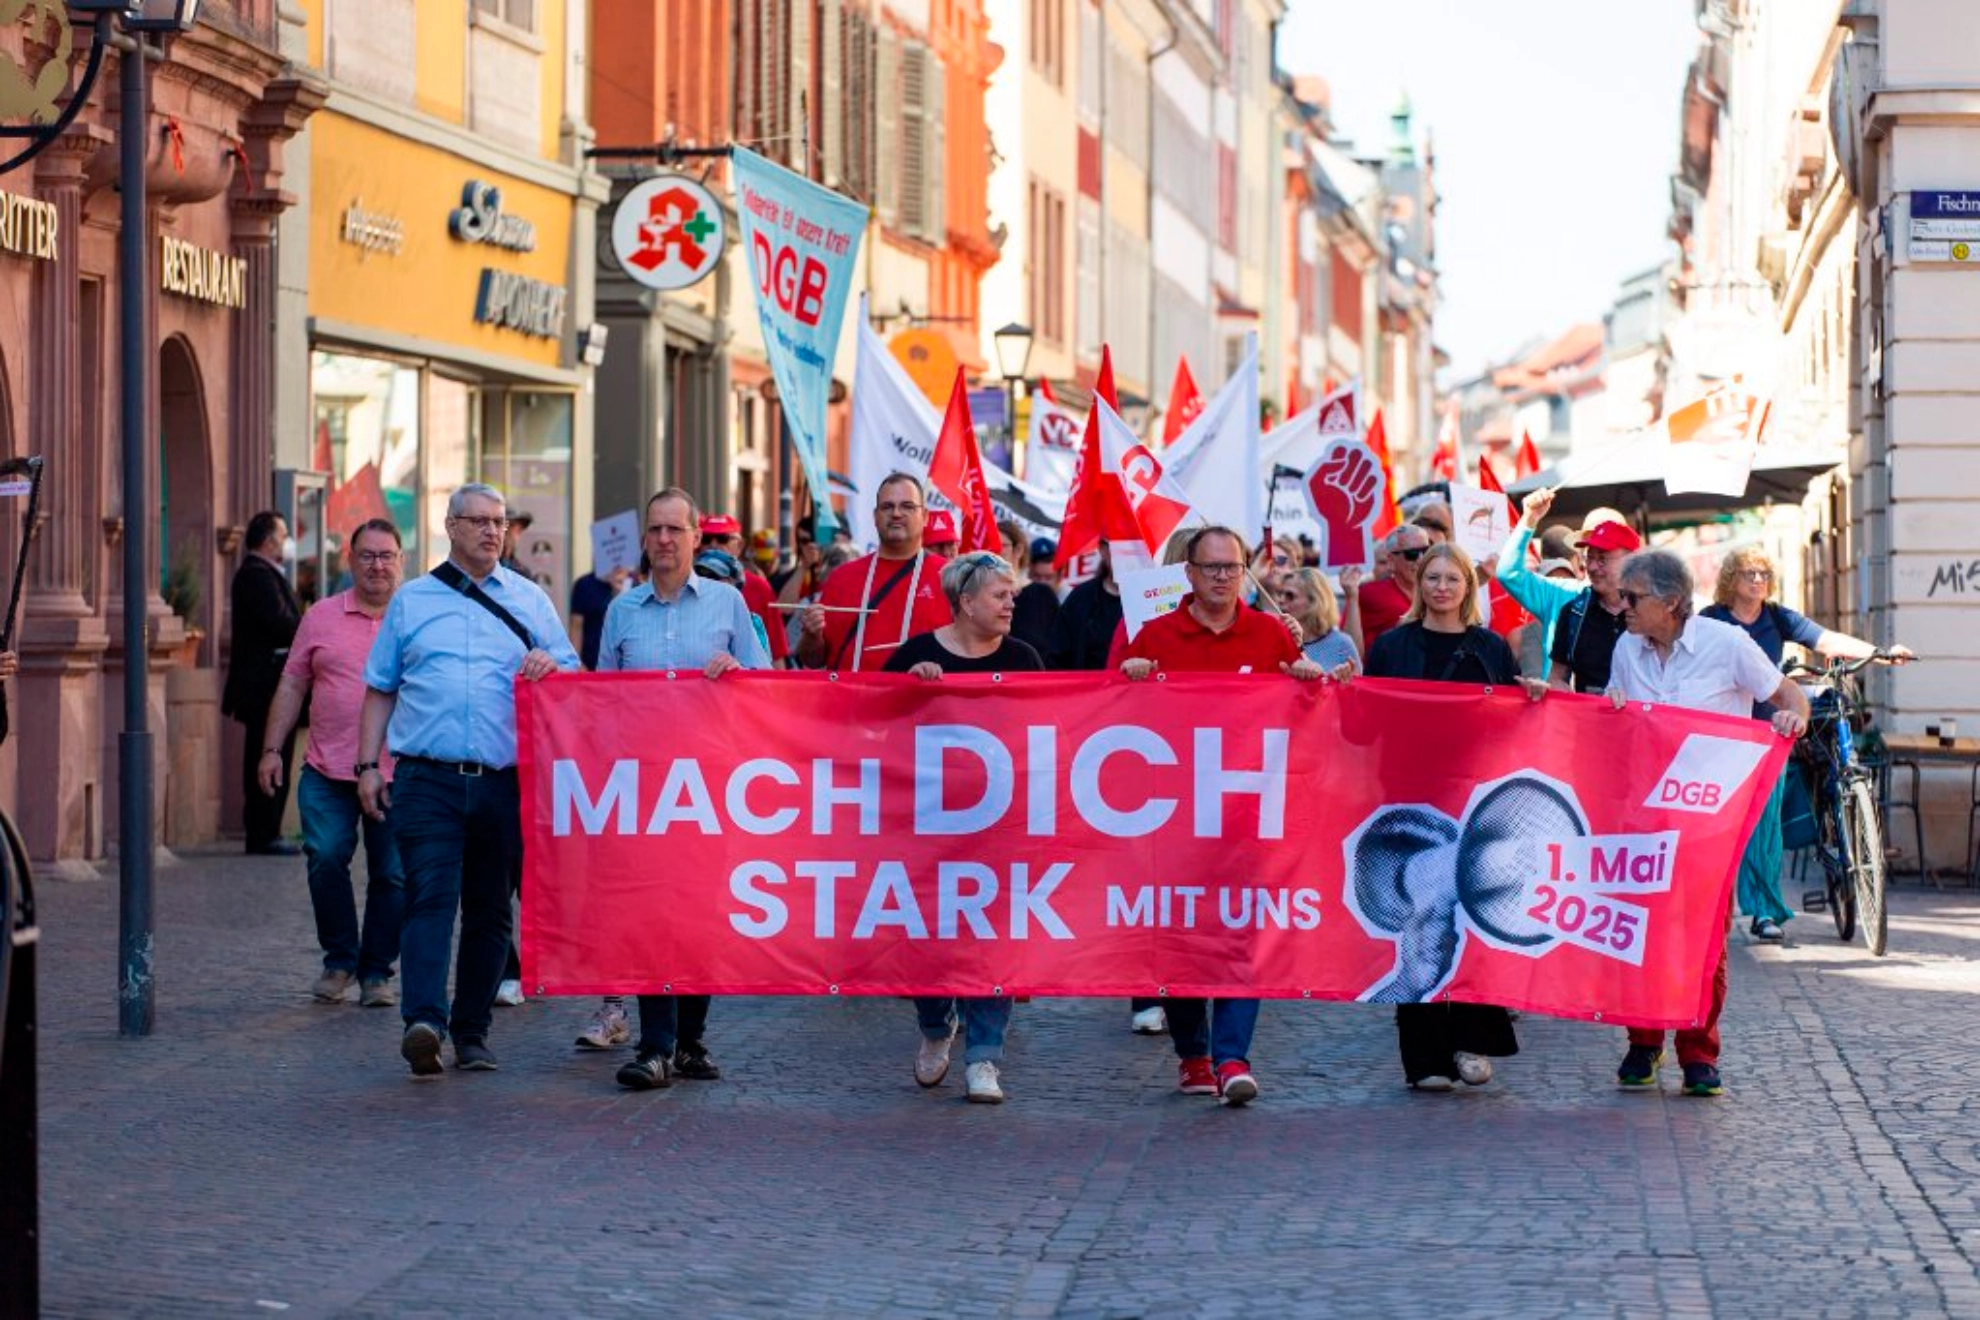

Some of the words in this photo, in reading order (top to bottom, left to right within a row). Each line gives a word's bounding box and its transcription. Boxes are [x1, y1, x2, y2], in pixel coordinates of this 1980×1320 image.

[0, 190, 58, 260] RITTER
[161, 235, 247, 309] RESTAURANT
[753, 228, 829, 327] DGB
[552, 758, 881, 836] MACH
[914, 724, 1290, 839] DICH
[1661, 779, 1721, 806] DGB
[1547, 843, 1577, 882] 1.
[1590, 841, 1668, 883] Mai
[728, 860, 1075, 939] STARK
[1107, 885, 1205, 928] MIT
[1218, 888, 1322, 930] UNS
[1526, 884, 1639, 951] 2025
